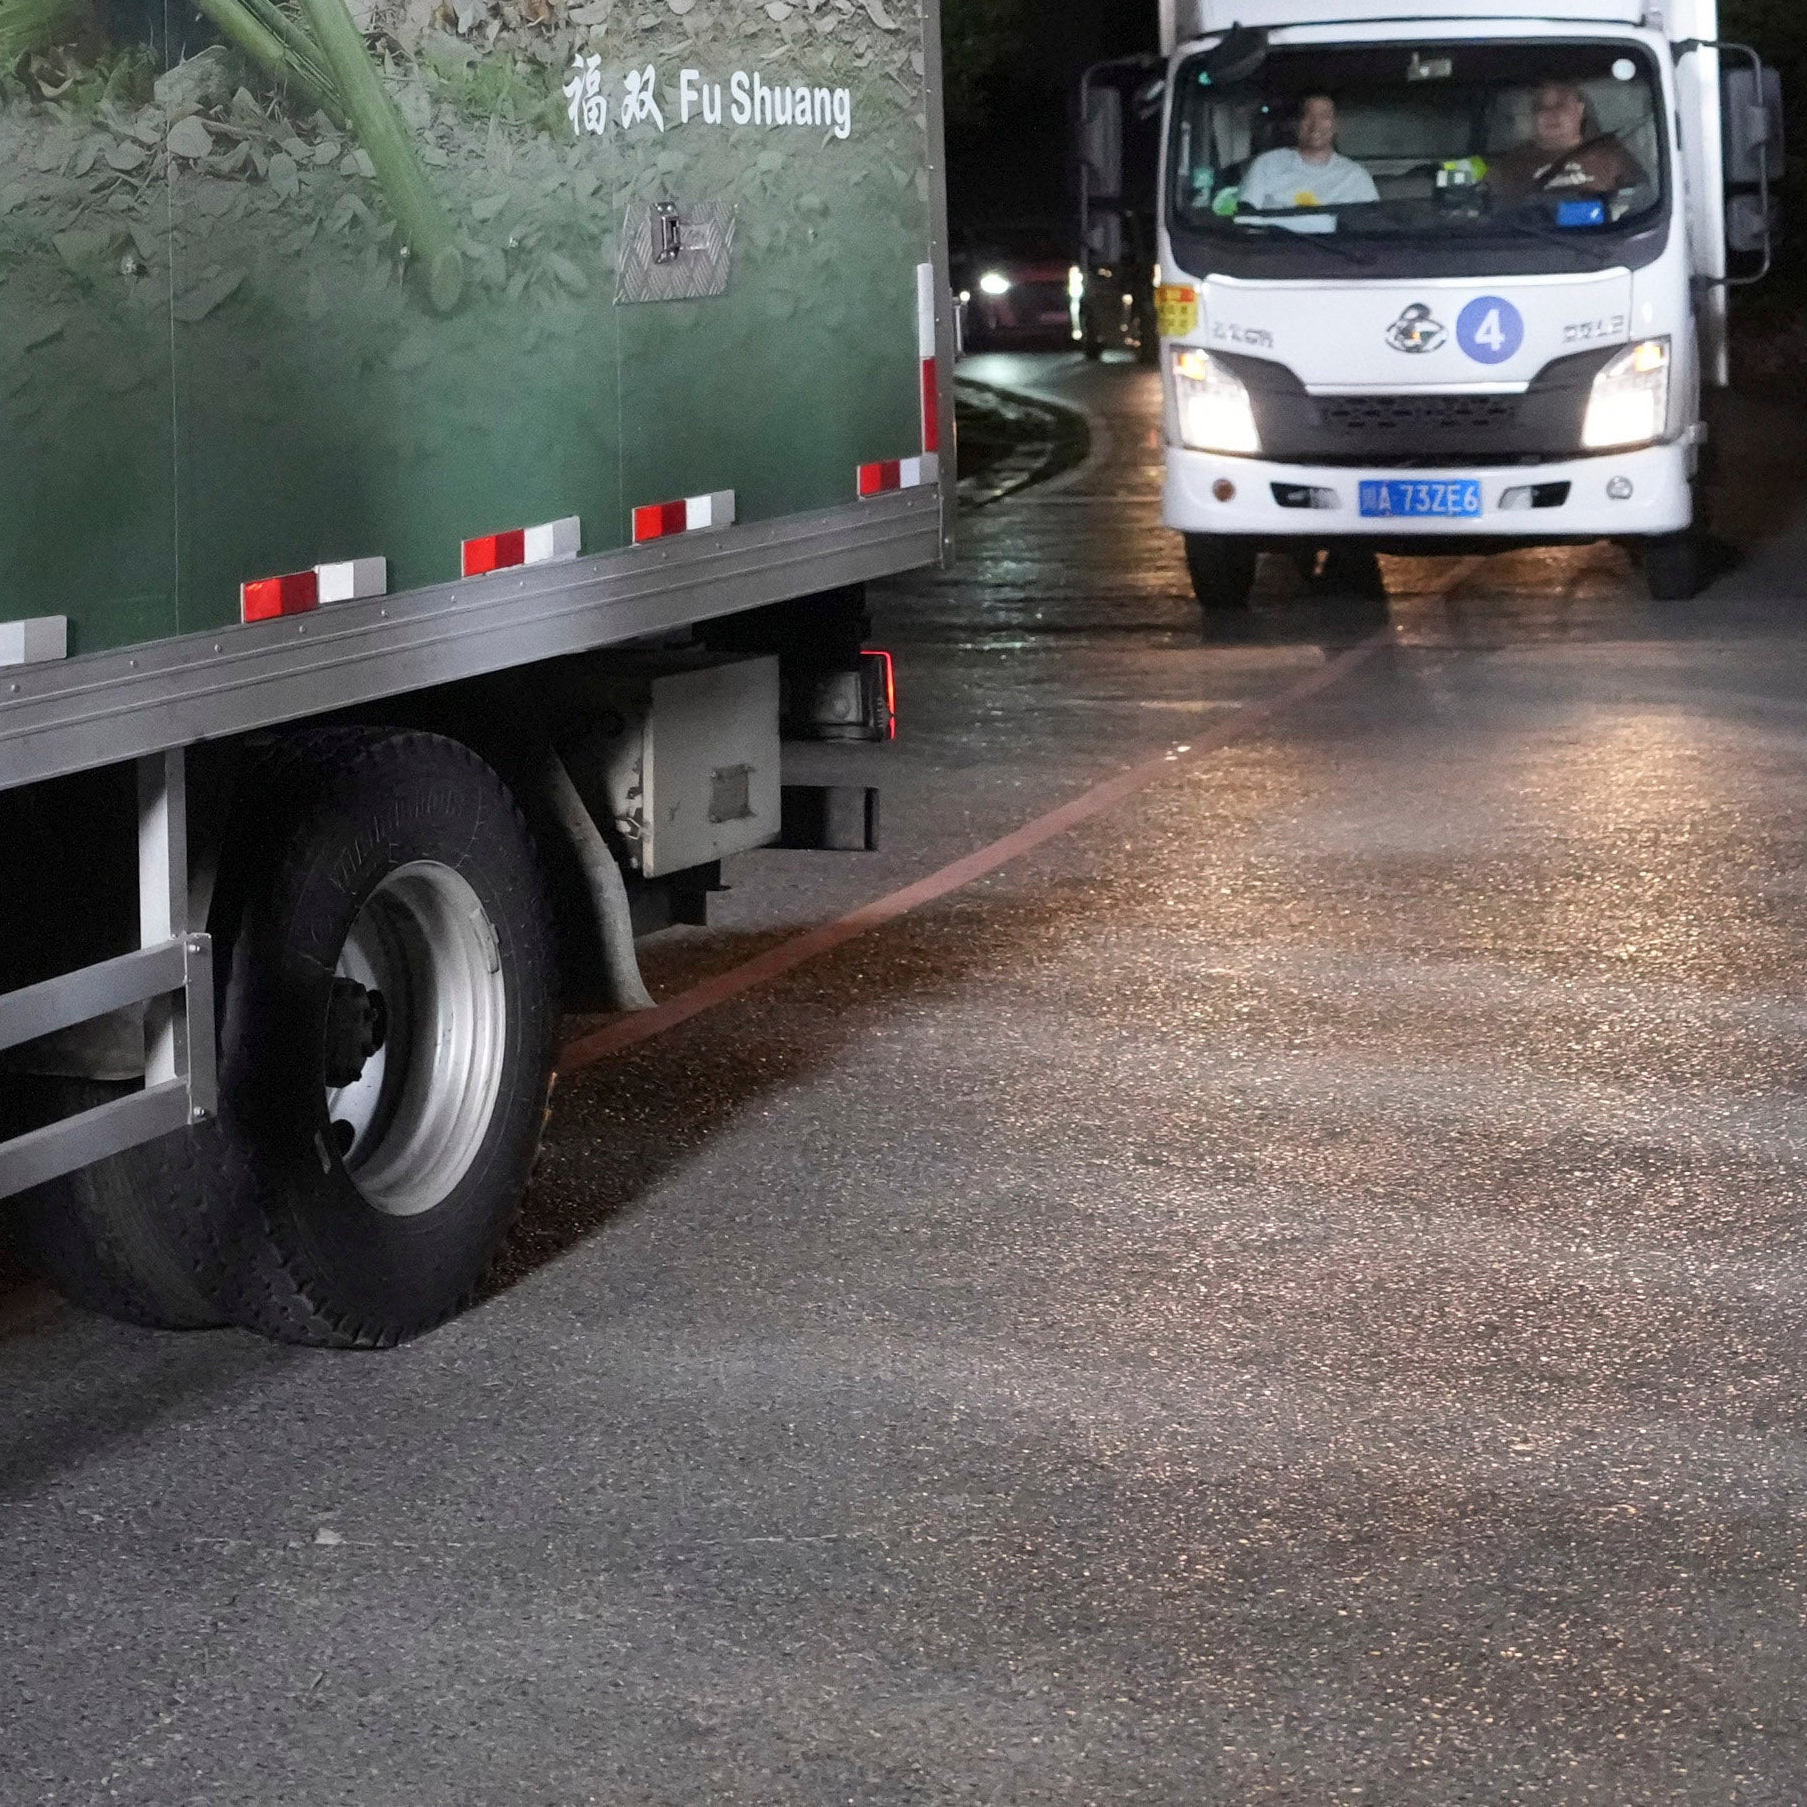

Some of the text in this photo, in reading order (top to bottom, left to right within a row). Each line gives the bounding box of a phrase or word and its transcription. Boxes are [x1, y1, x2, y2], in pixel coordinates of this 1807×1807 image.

[680, 68, 722, 125] Fu
[730, 70, 852, 140] Shuang
[1474, 308, 1505, 352] 4
